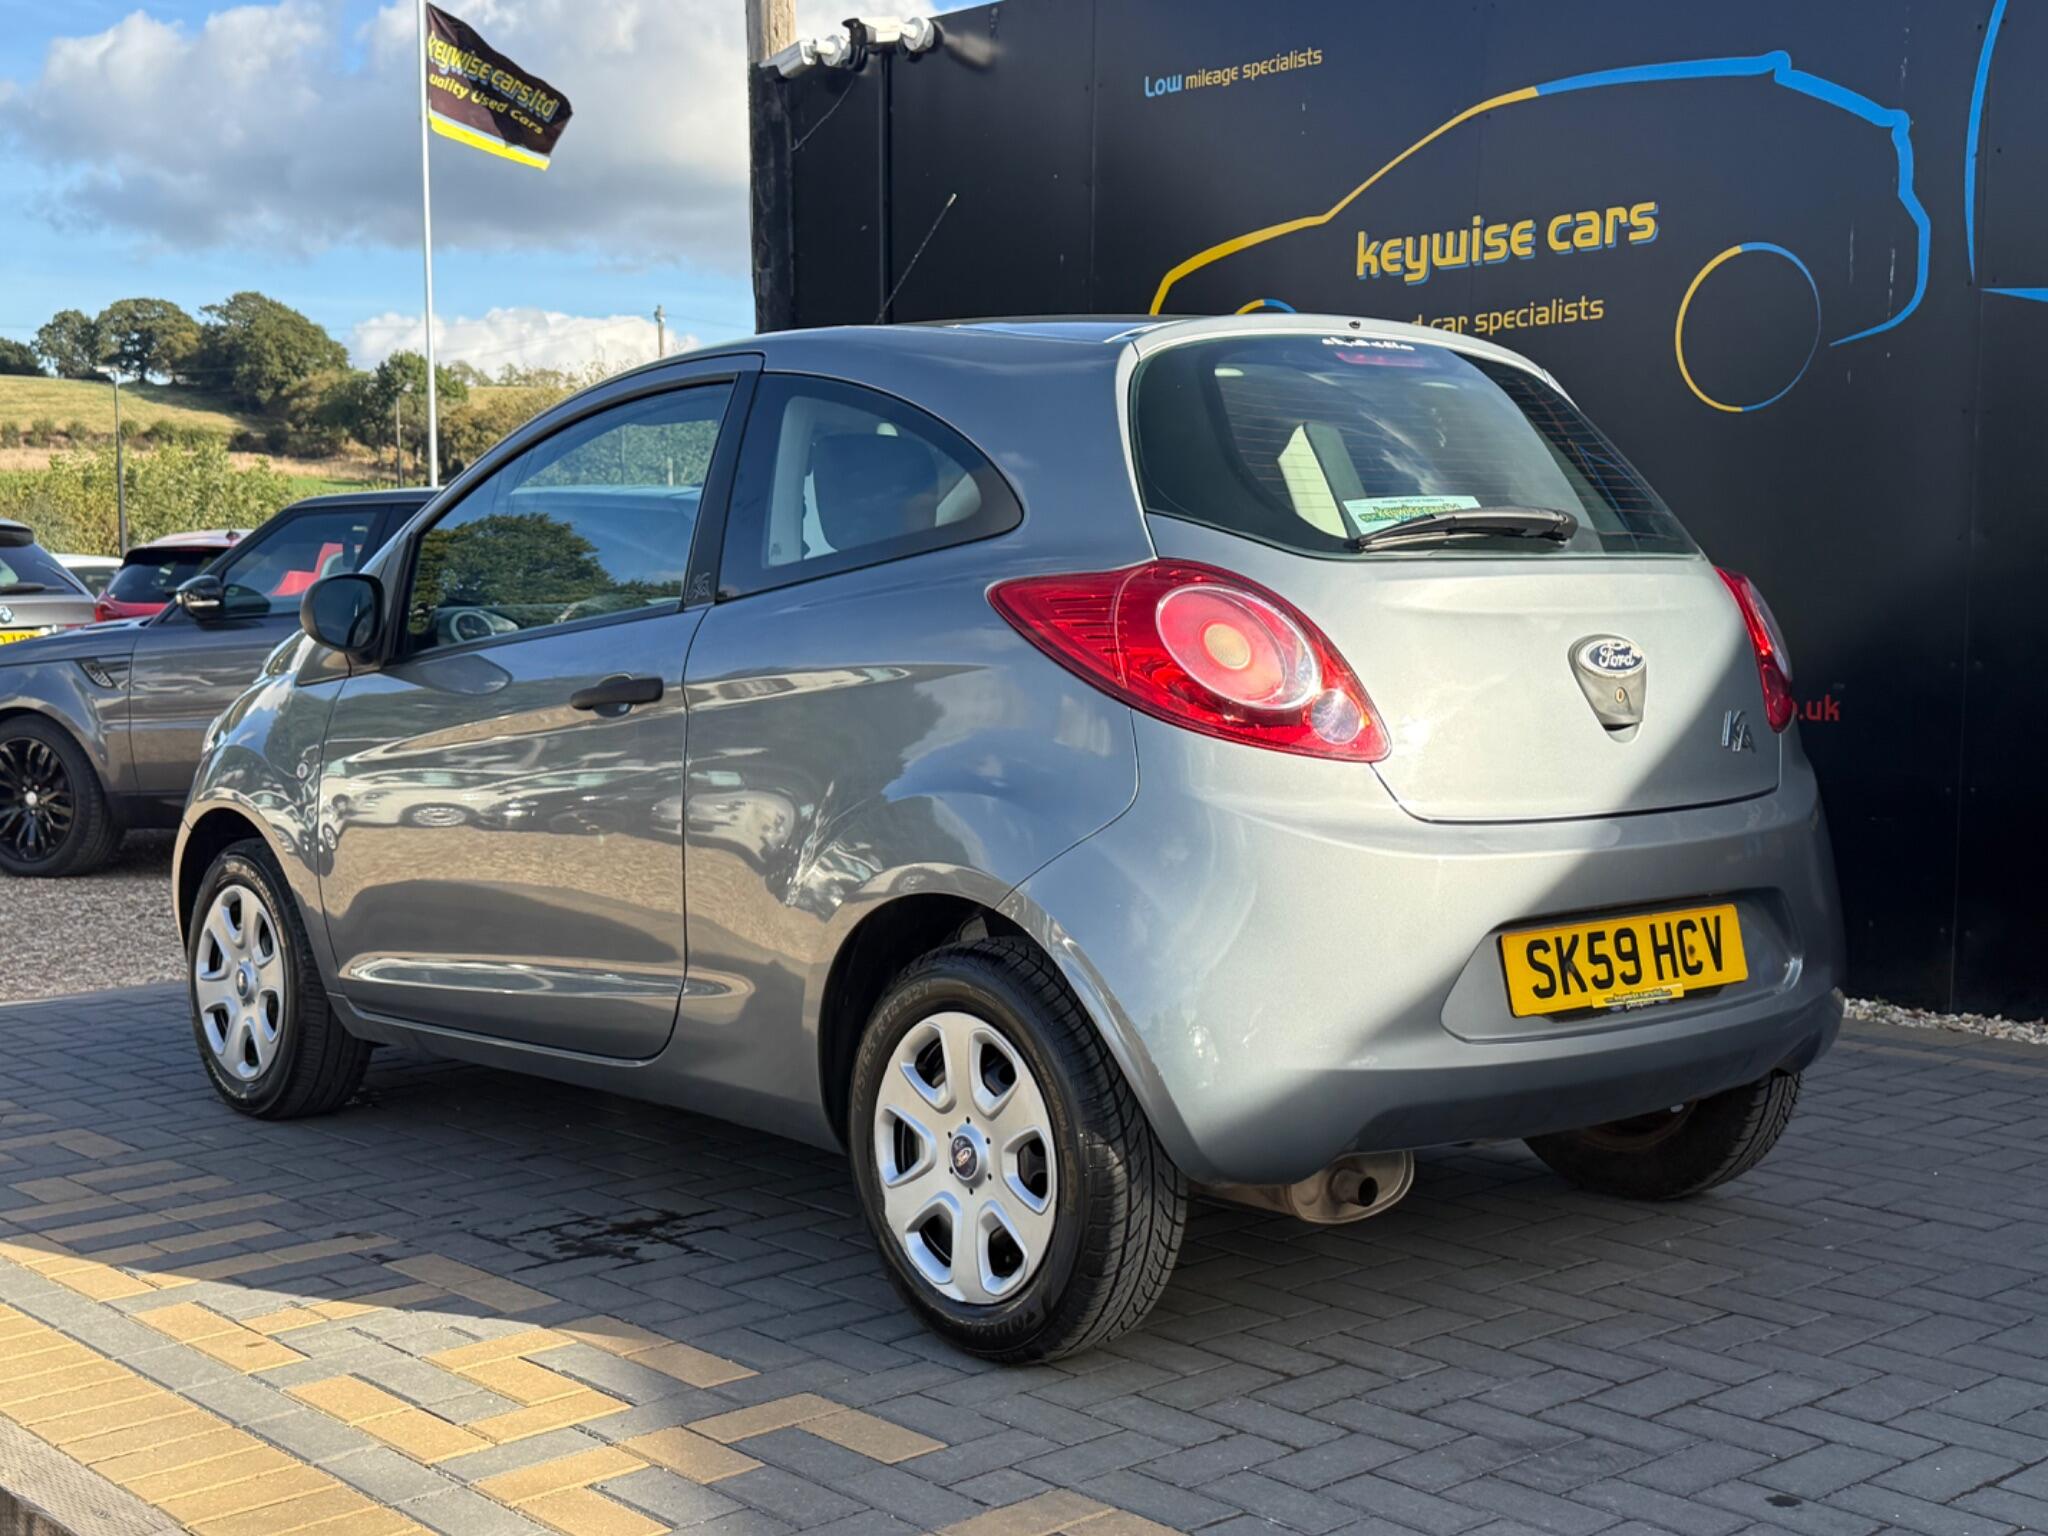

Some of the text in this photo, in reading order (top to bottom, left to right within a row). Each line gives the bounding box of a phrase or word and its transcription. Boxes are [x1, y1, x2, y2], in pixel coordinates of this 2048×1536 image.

[491, 69, 533, 103] cars
[528, 89, 558, 117] ltd
[1144, 47, 1323, 97] Low mileage specialists
[429, 73, 543, 135] uality Used Cars
[1356, 201, 1659, 286] keywise cars
[1474, 295, 1604, 336] specialists
[1598, 643, 1635, 668] Ford
[1525, 914, 1723, 999] SK59 HCV
